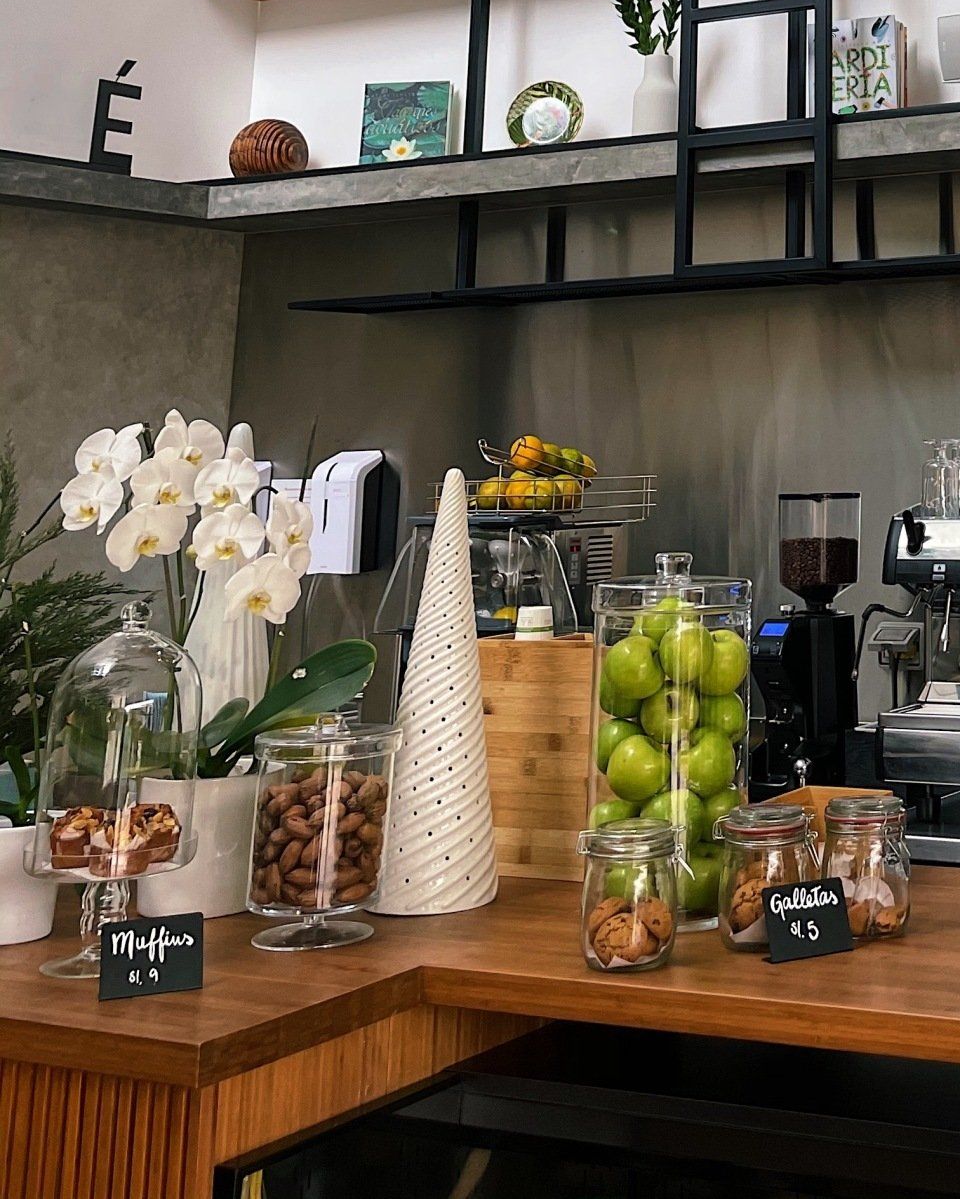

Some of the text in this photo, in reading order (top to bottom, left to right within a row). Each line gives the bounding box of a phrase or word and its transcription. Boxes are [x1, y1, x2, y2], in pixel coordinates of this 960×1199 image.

[832, 44, 890, 73] ARDI
[832, 71, 892, 102] ERIA
[770, 885, 839, 921] Galletas
[111, 925, 194, 963] Muffins
[807, 920, 819, 941] 5
[149, 967, 159, 983] 9
